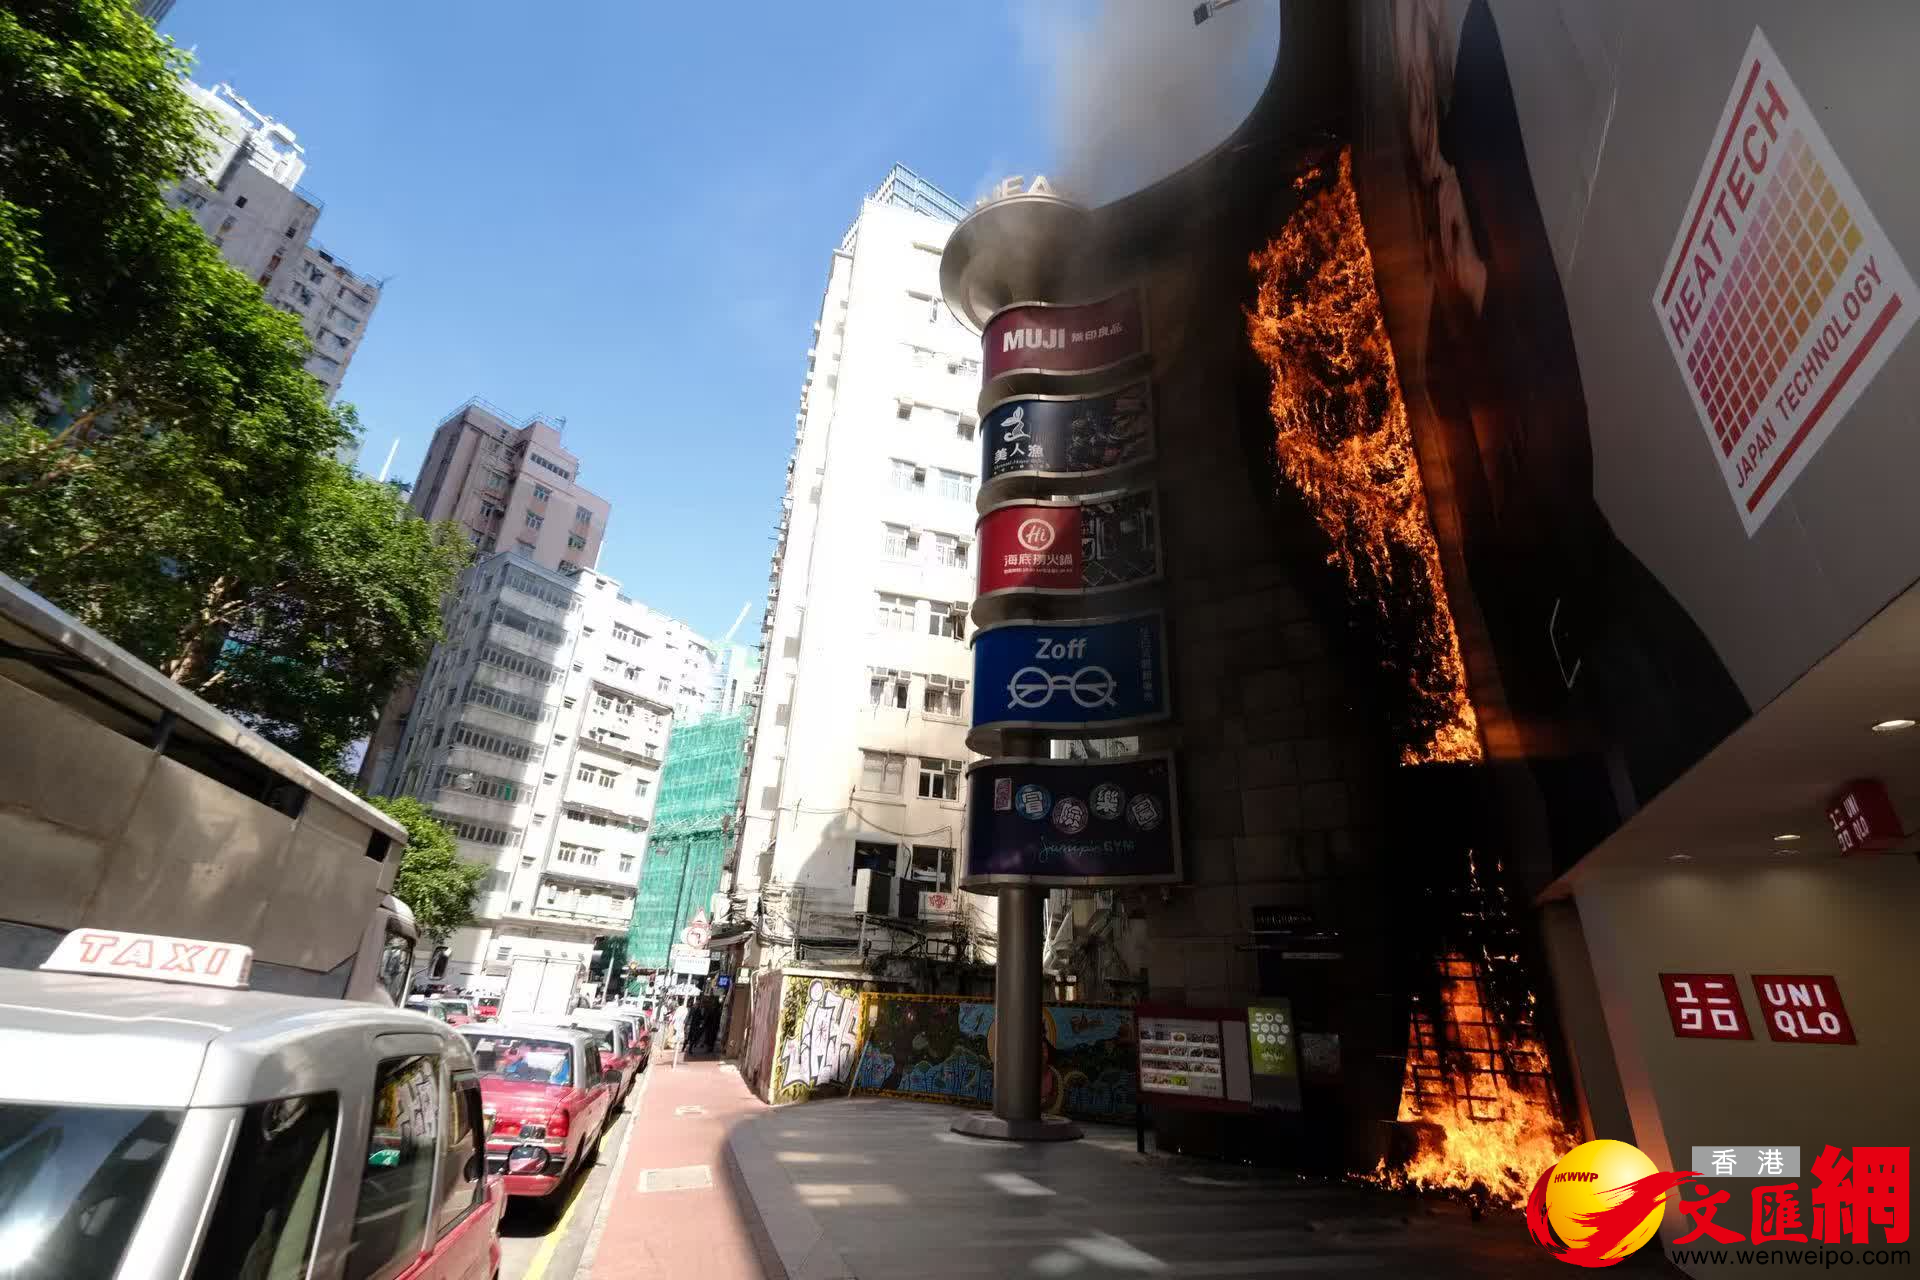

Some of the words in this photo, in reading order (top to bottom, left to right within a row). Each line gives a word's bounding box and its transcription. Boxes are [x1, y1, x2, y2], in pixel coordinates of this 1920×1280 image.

[1667, 80, 1790, 349] HEATTECH
[1003, 328, 1065, 352] MUJI
[1071, 321, 1123, 343] 無印良品
[1734, 414, 1778, 489] JAPAN
[1775, 255, 1884, 422] TECHNOLOGY
[1026, 525, 1047, 542] Hi
[1035, 638, 1087, 660] Zoff
[80, 934, 230, 976] TAXI
[1673, 982, 1732, 1004] ユニ
[1763, 984, 1828, 1007] UNI
[1681, 1008, 1740, 1031] クロ
[1774, 1011, 1841, 1037] QLO
